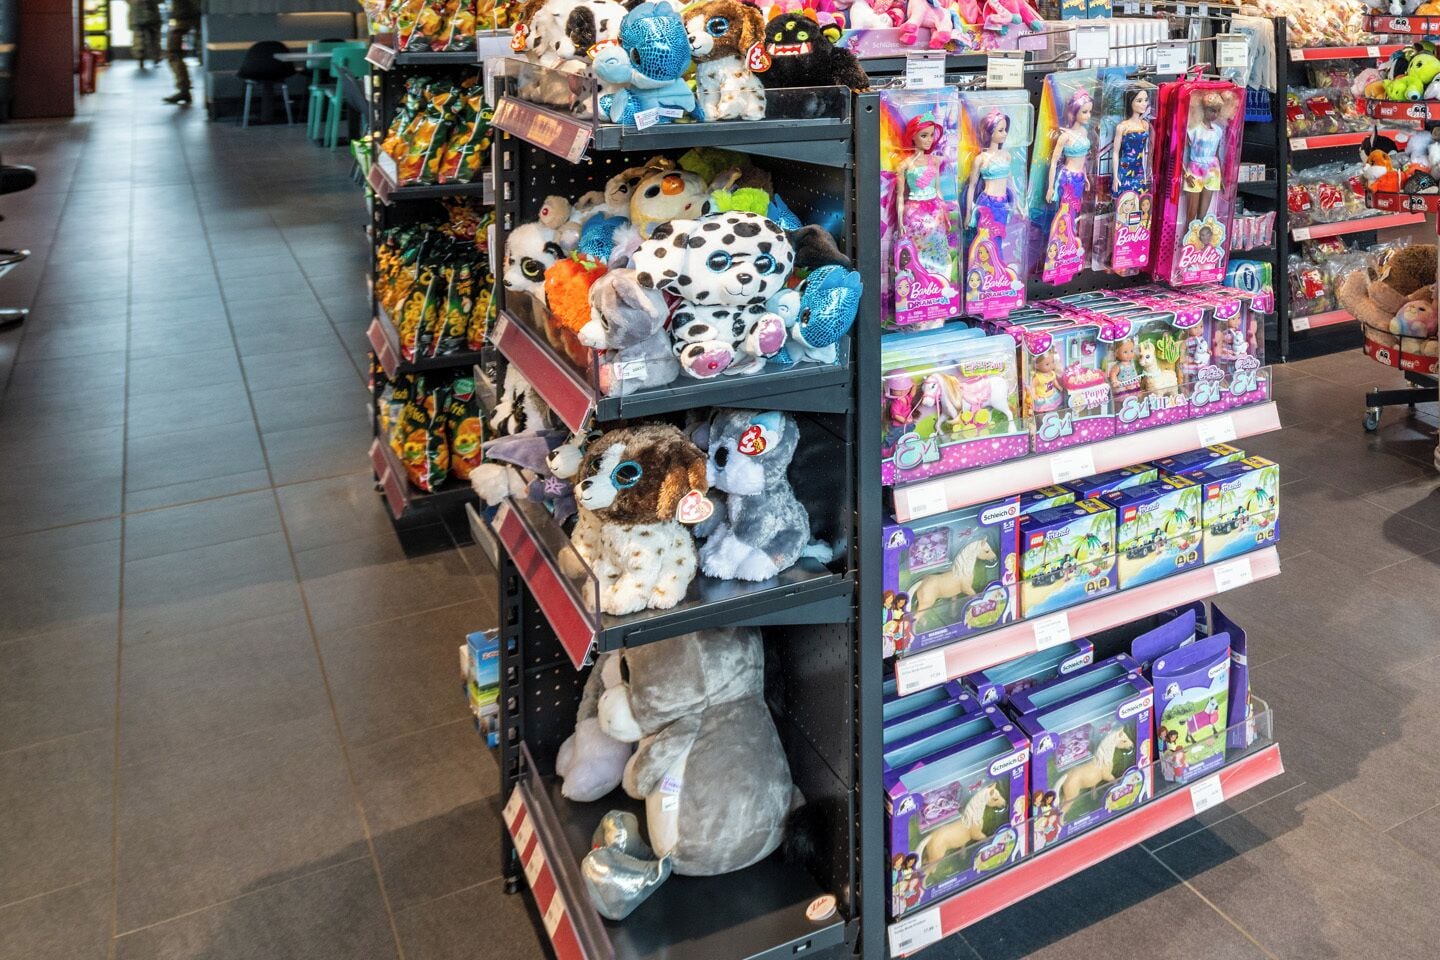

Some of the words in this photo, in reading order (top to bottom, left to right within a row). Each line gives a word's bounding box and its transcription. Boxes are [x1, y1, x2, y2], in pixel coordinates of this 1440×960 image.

[1115, 226, 1150, 246] Barbie
[1058, 243, 1077, 259] Barbie
[1179, 245, 1220, 268] Barbie
[910, 280, 943, 299] Barbie
[982, 274, 1011, 291] Barbie
[1084, 385, 1110, 399] Puppy
[983, 510, 1008, 522] Schleich
[1062, 658, 1084, 671] Schleich
[1120, 703, 1143, 716] Schleich
[992, 758, 1017, 772] Schleich
